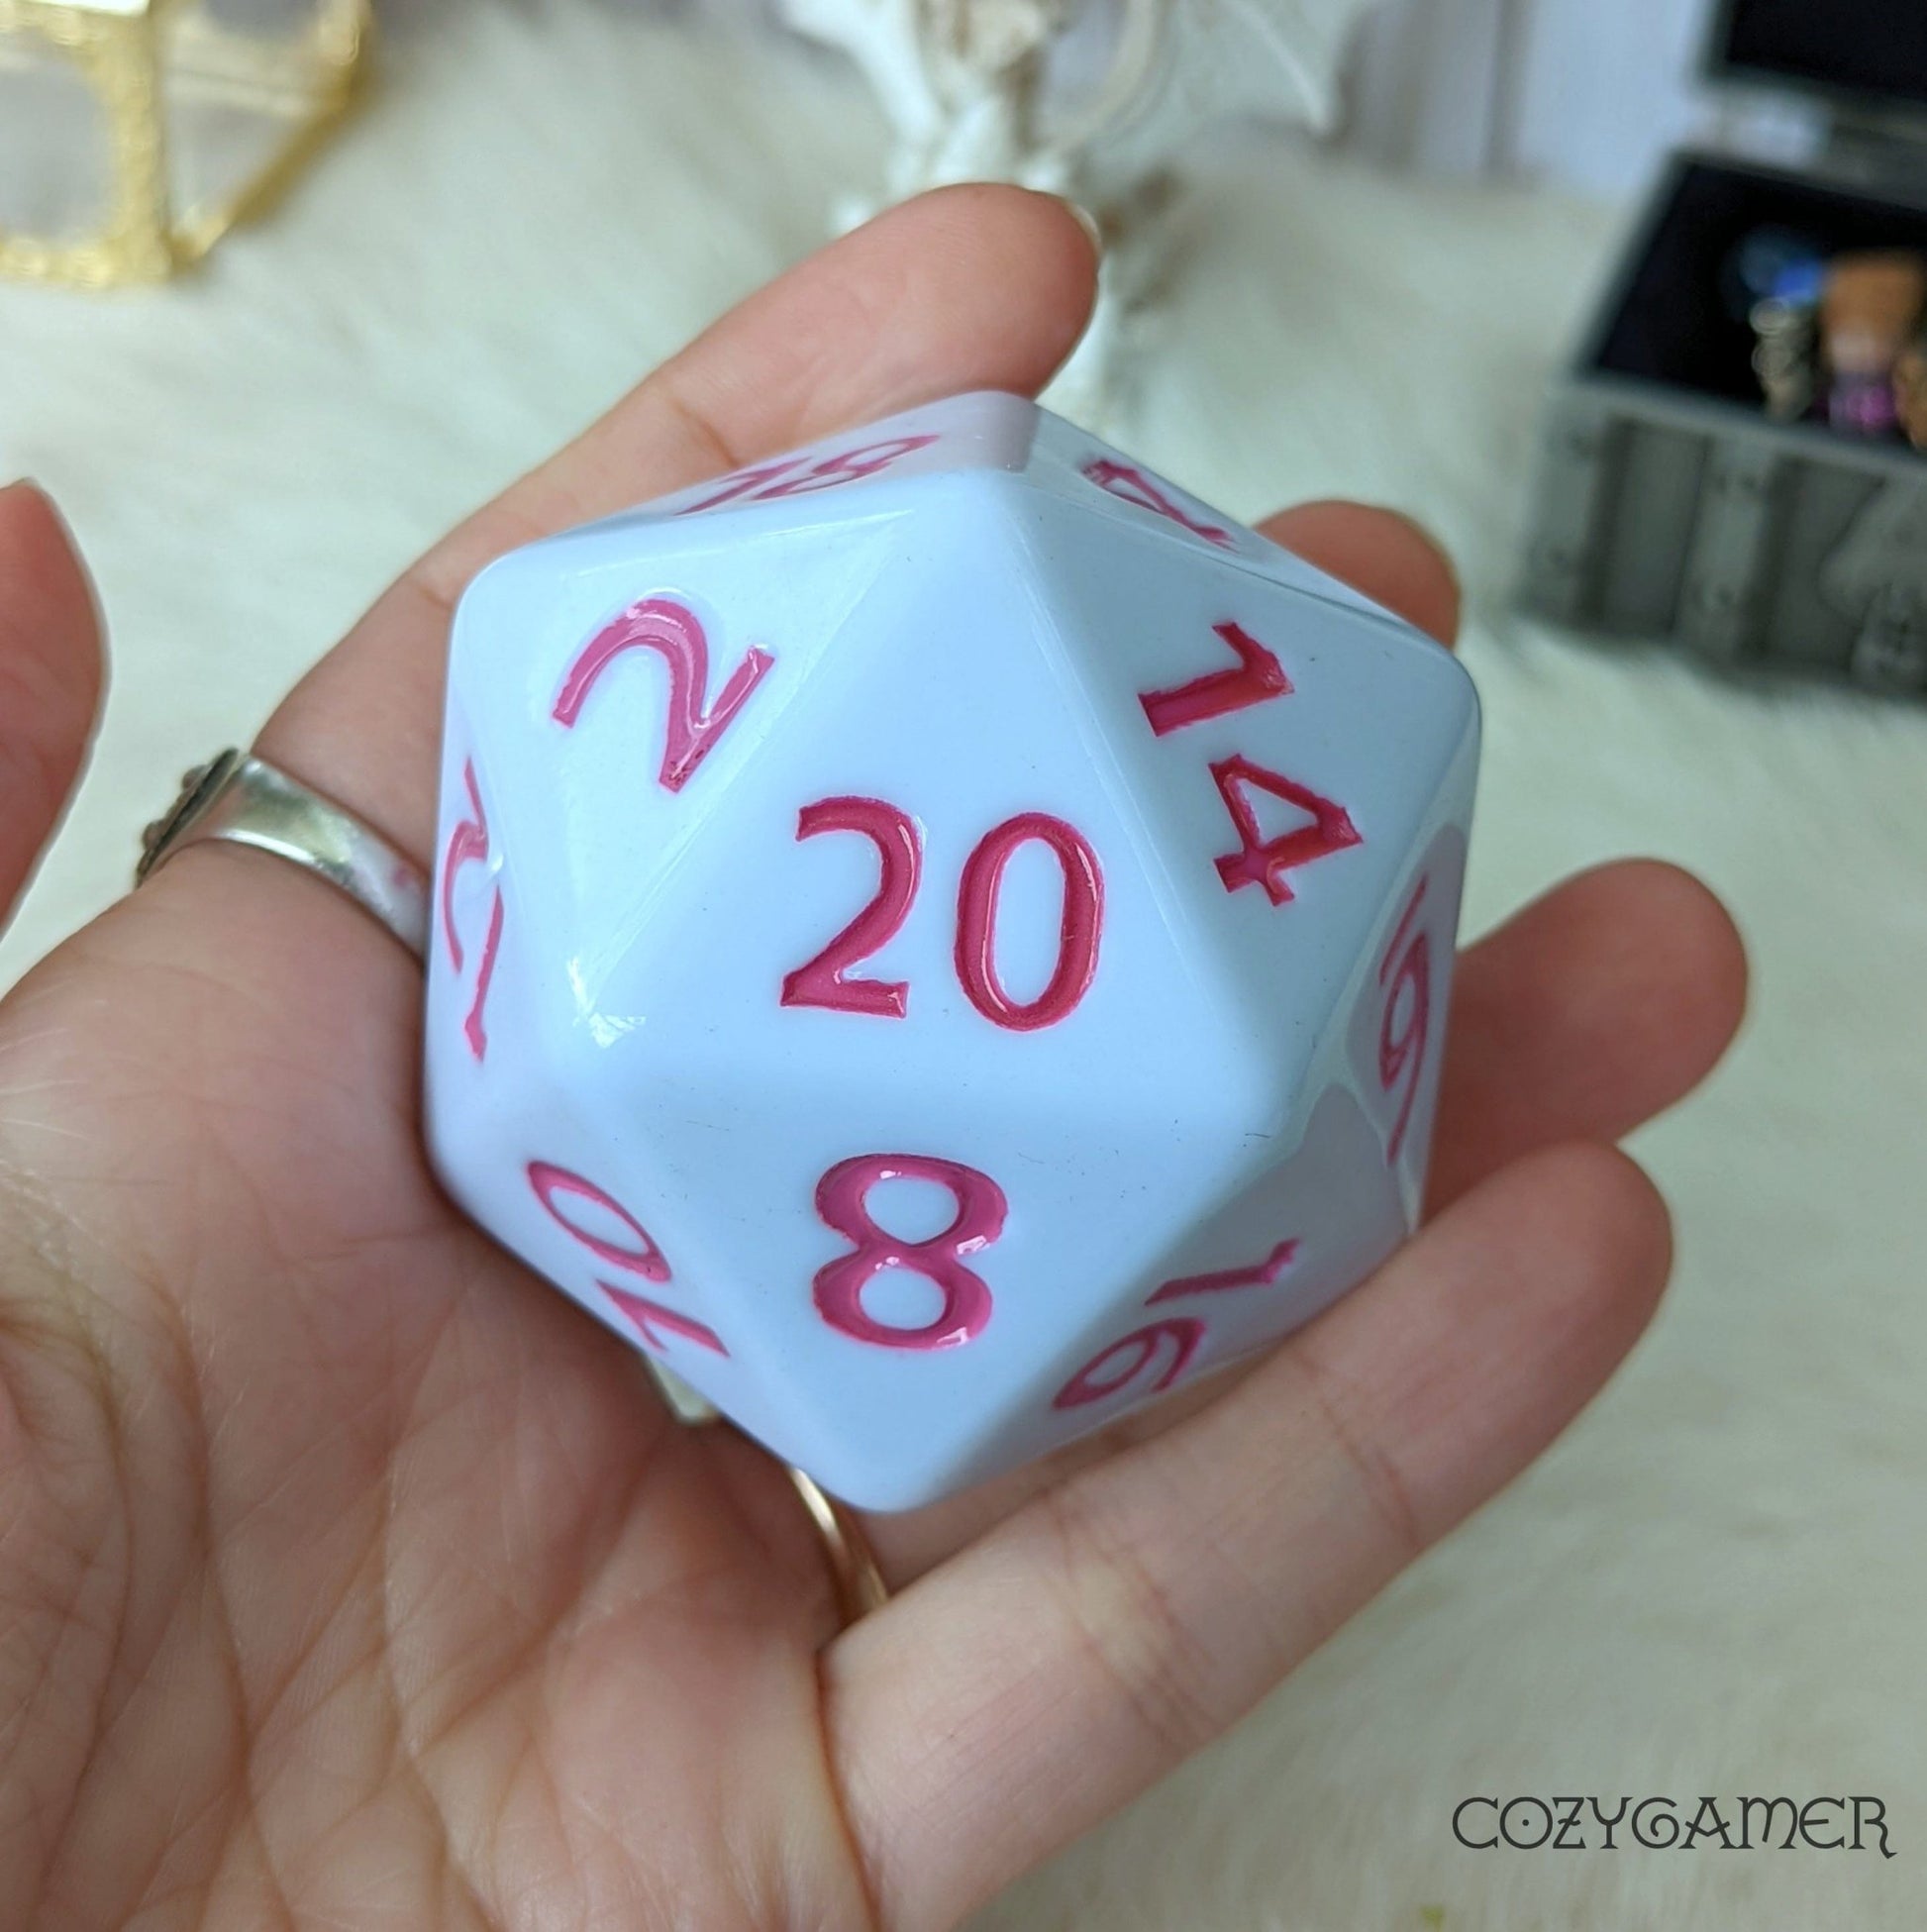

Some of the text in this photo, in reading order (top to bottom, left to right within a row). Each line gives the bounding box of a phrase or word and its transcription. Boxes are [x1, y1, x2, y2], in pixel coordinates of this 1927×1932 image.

[673, 434, 941, 515] 18
[552, 598, 776, 794] 2
[1137, 621, 1365, 908] 14
[444, 756, 504, 1064] 12
[779, 795, 1106, 1033] 20
[526, 1160, 731, 1358] 10
[813, 1153, 1009, 1351] 8
[1052, 1237, 1300, 1410] 16
